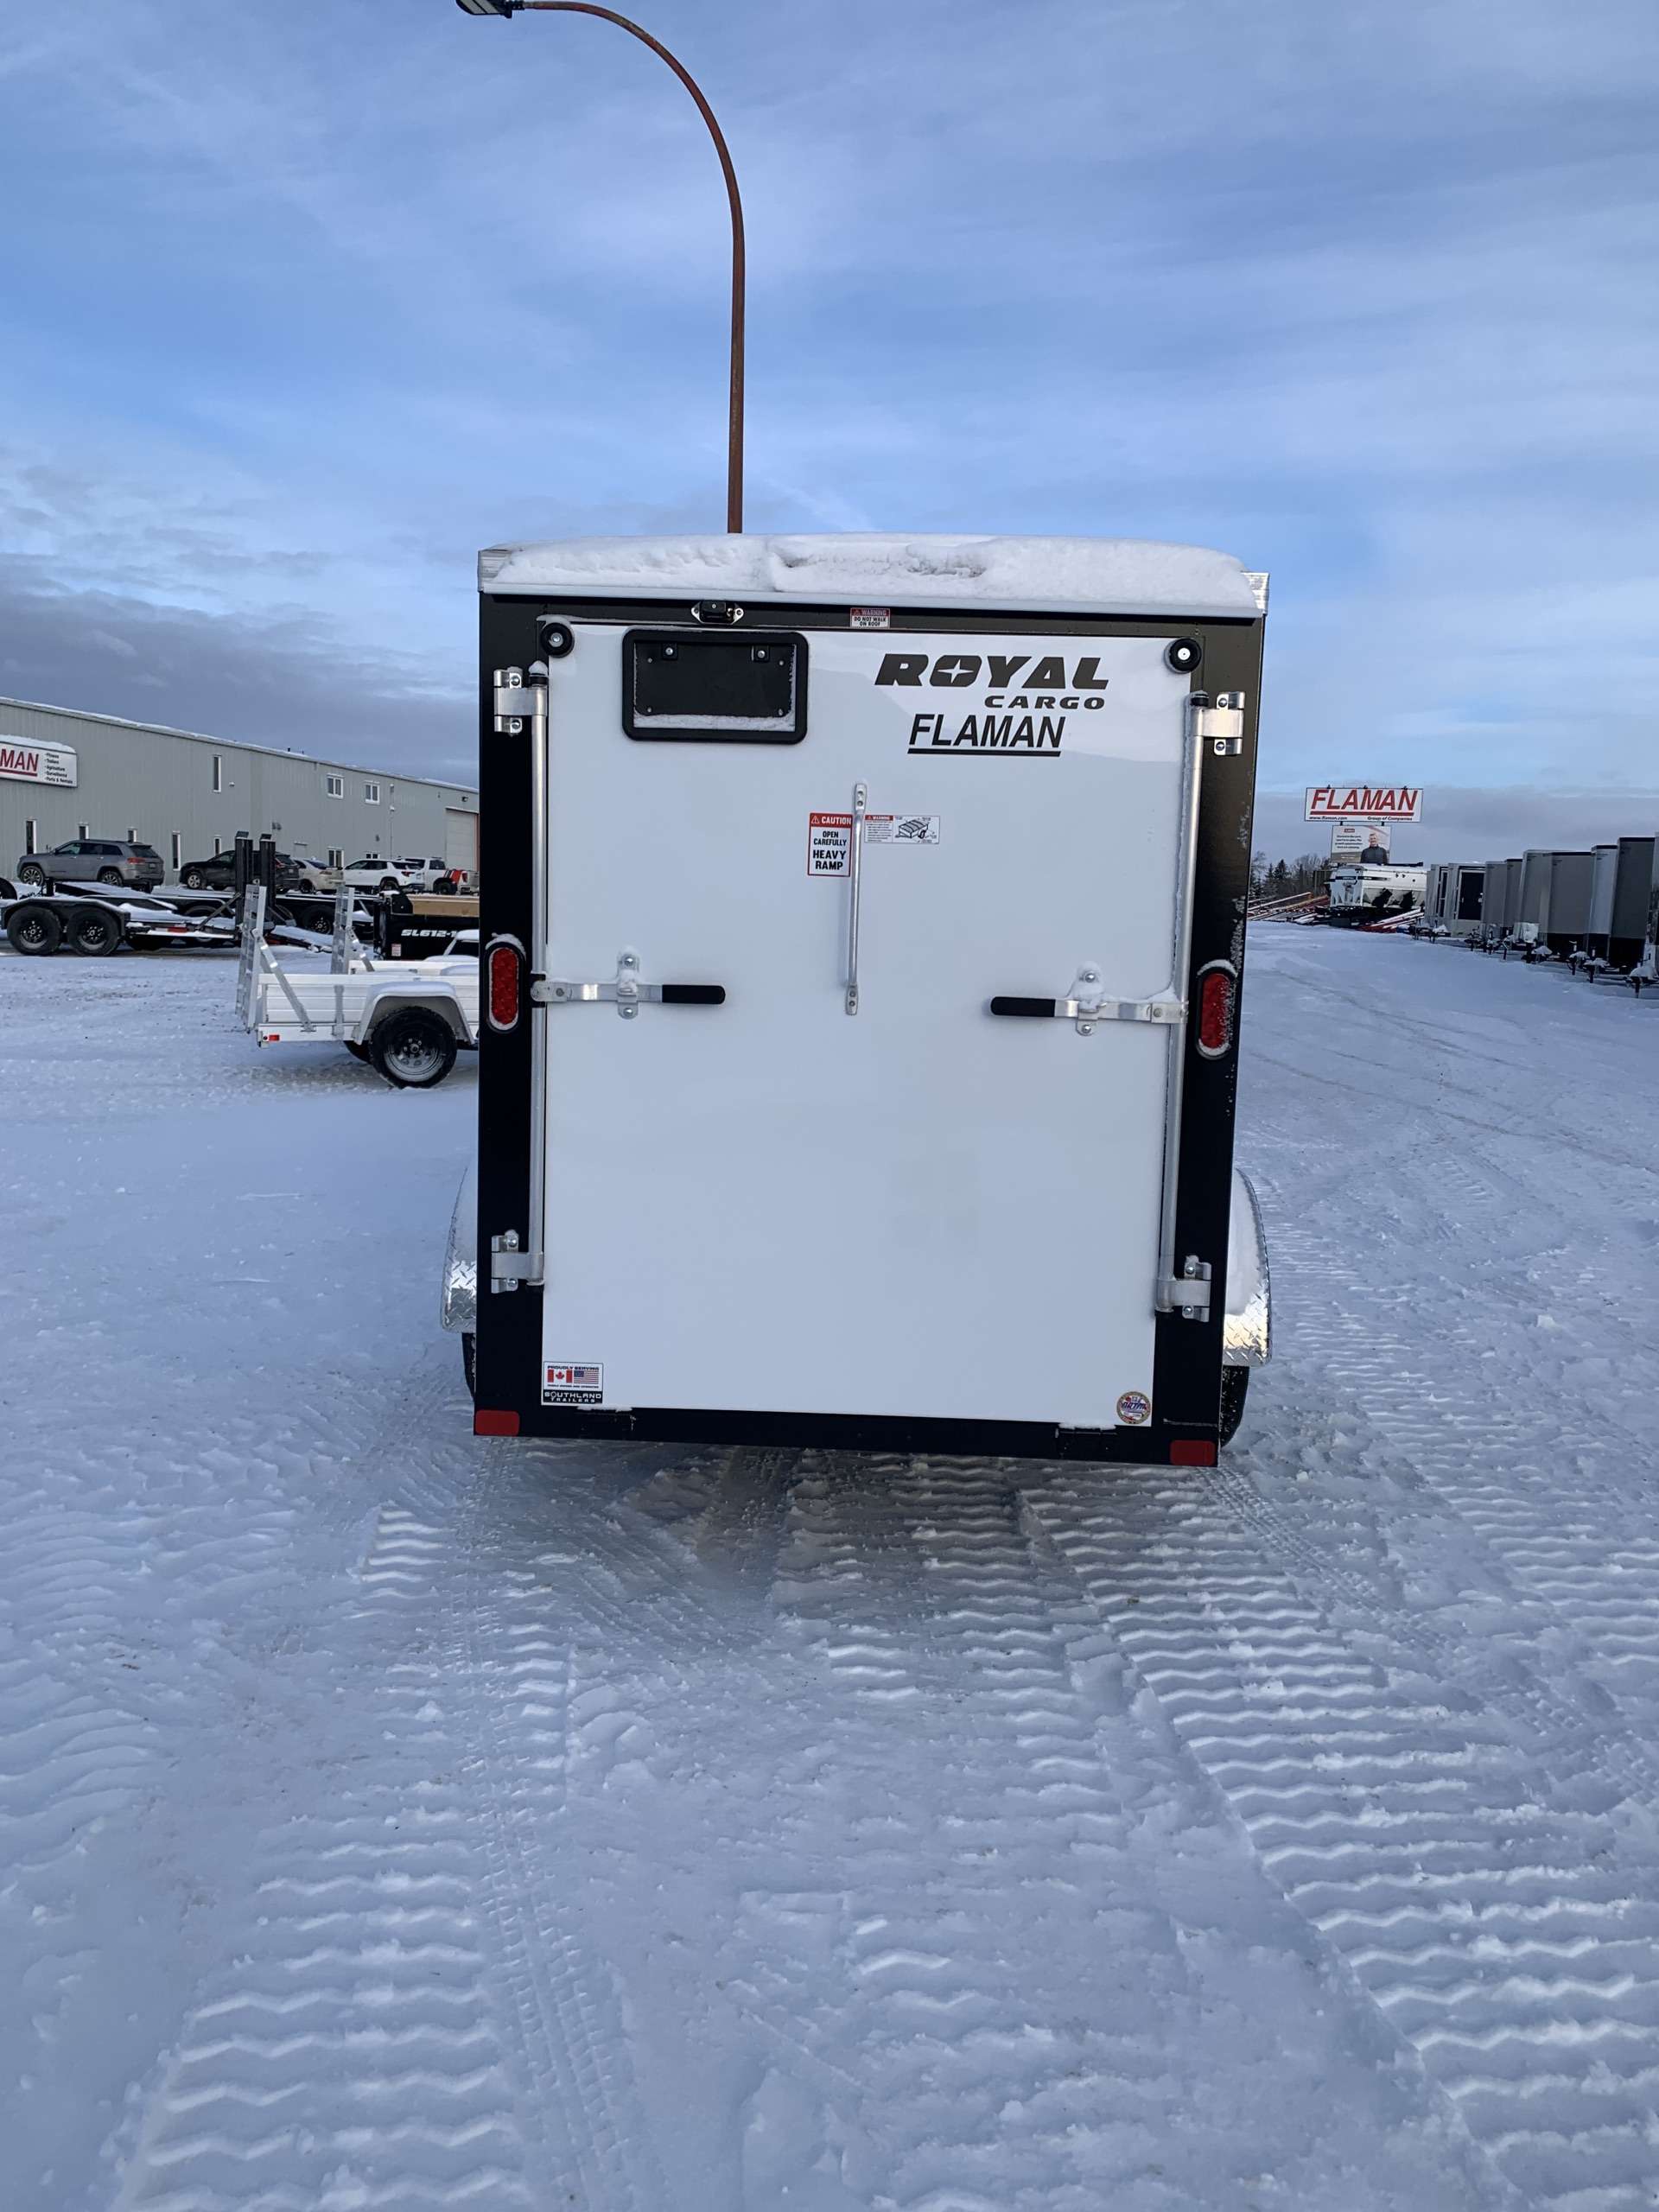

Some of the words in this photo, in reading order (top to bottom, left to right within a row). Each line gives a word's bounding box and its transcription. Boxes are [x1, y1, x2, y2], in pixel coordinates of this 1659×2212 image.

[874, 653, 1109, 690] ROYAL
[984, 696, 1105, 709] CARGO
[909, 714, 1066, 748] FLAMAN
[1311, 789, 1418, 810] FLAMAN
[821, 816, 852, 824] CAUTION
[812, 849, 846, 860] HEAVY
[815, 861, 843, 870] RAMP
